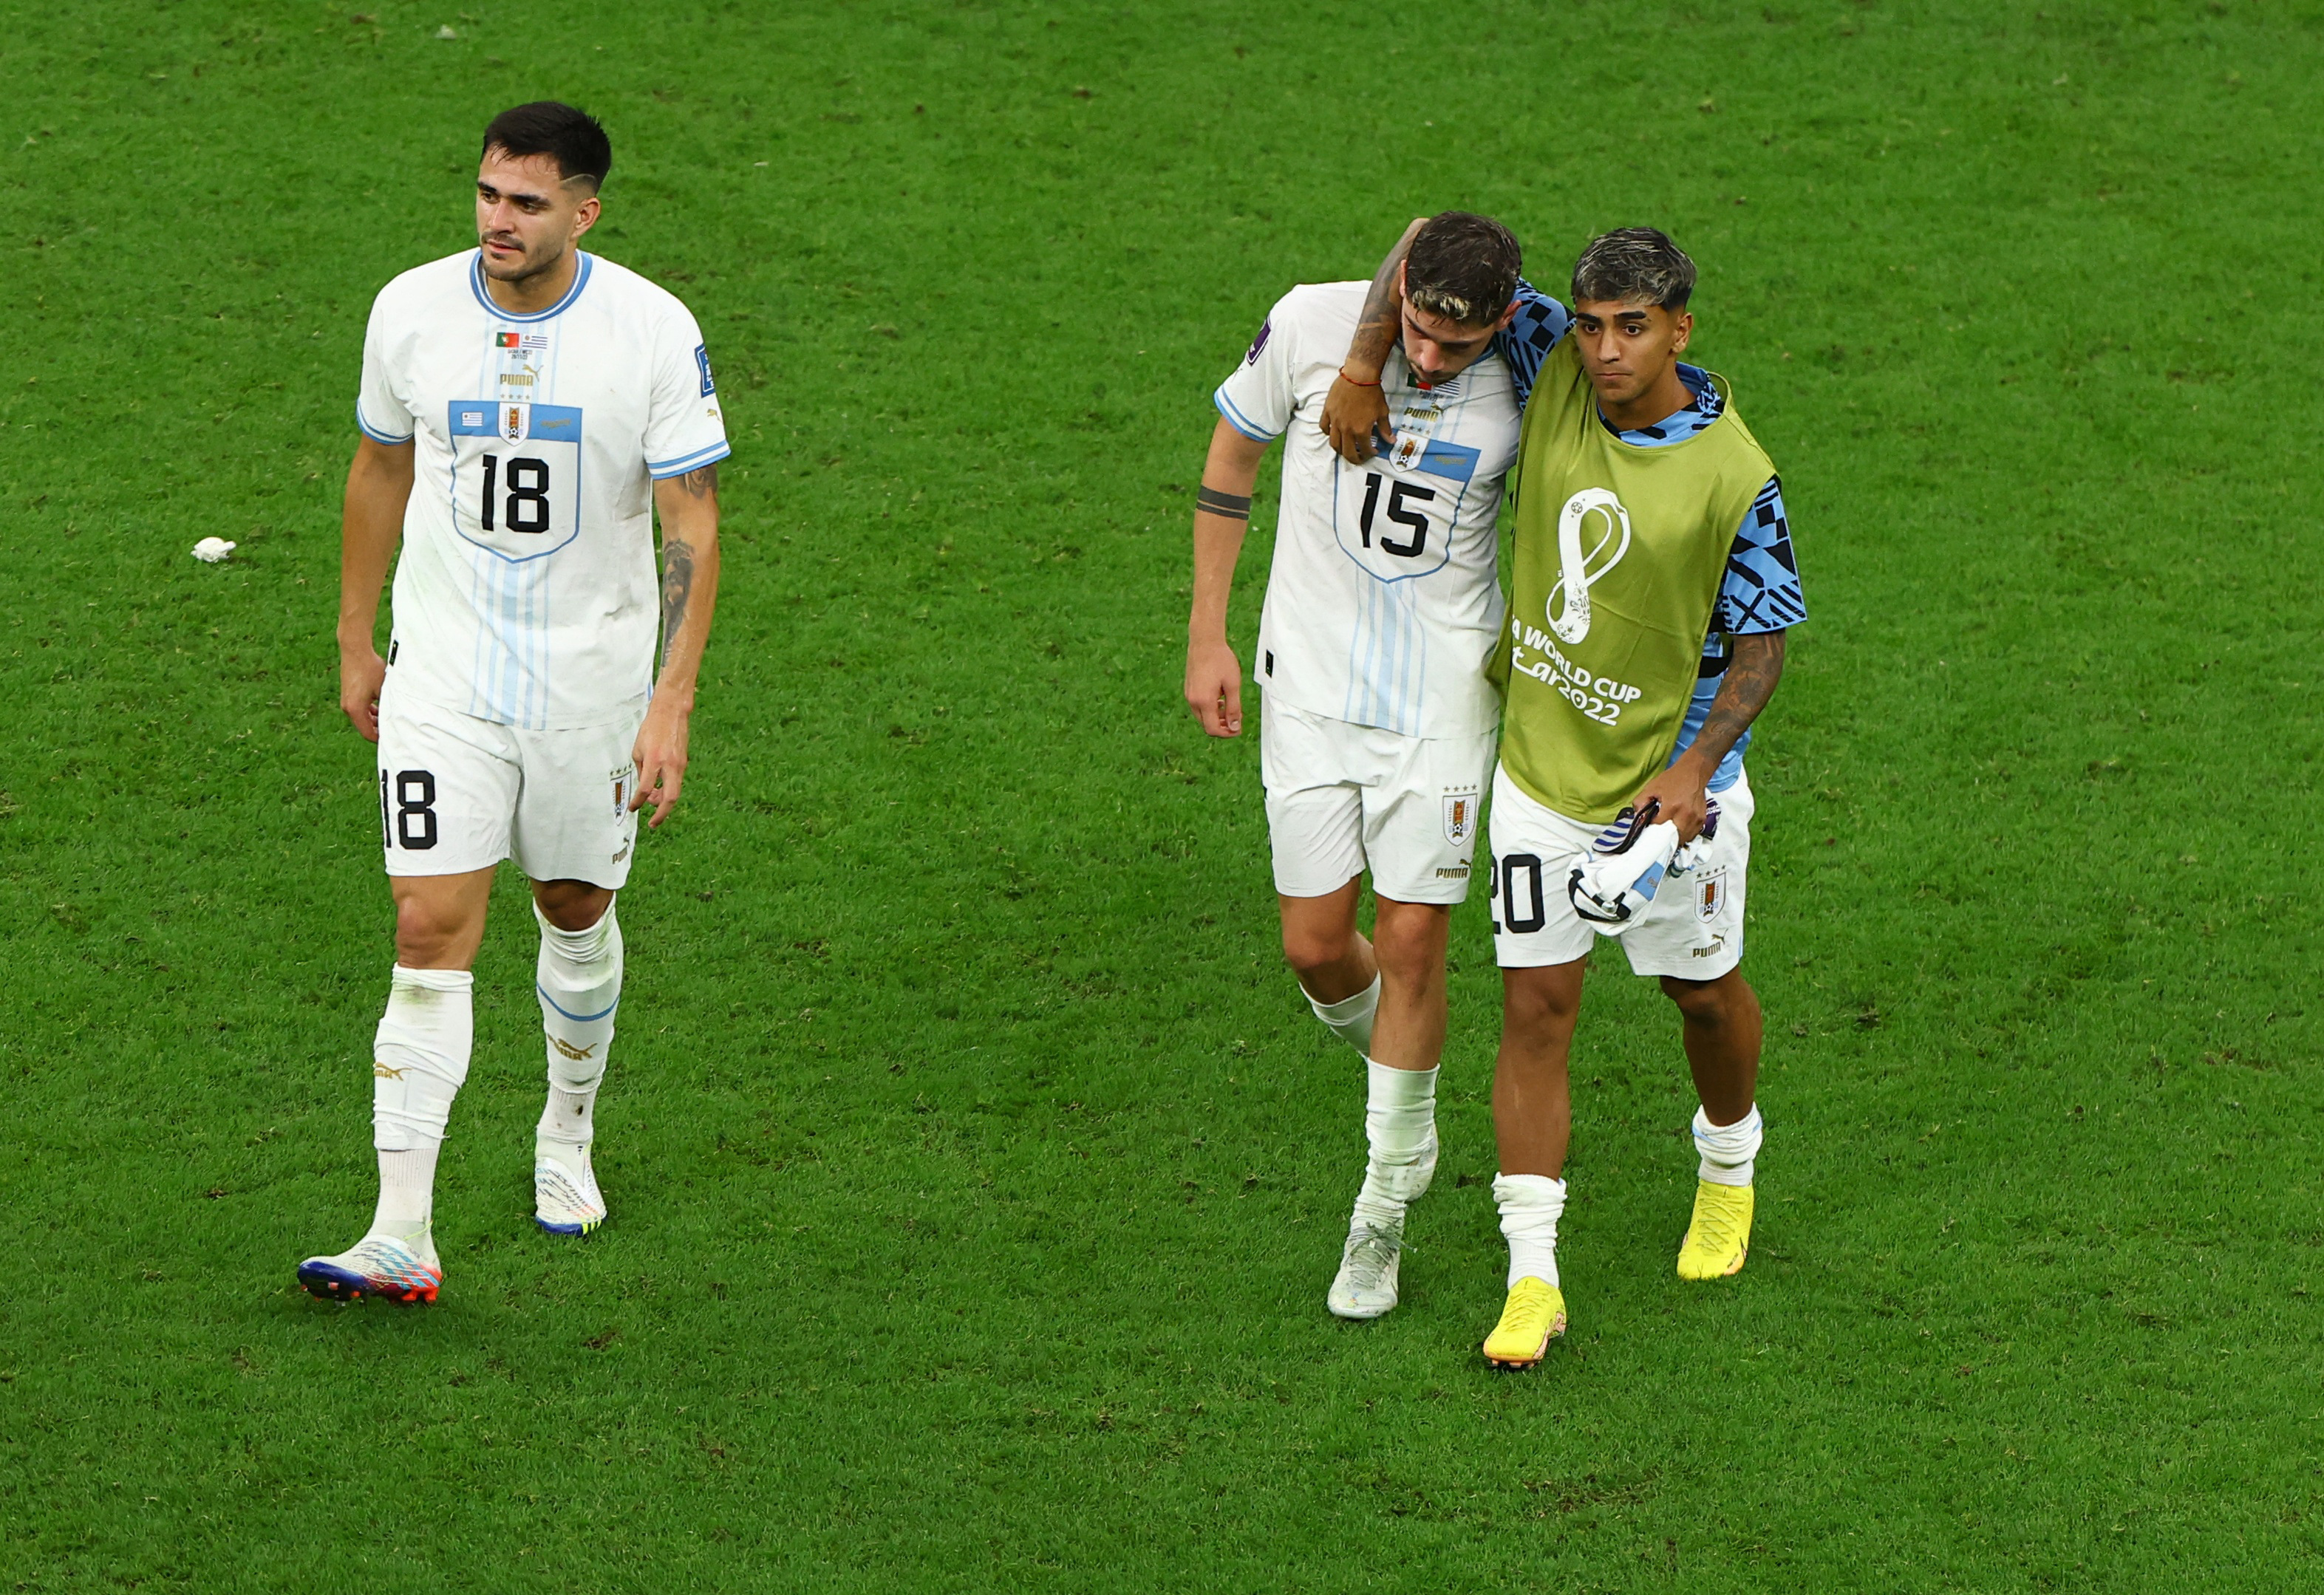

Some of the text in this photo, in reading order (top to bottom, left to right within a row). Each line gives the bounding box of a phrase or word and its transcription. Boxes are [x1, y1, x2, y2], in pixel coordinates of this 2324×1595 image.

[500, 374, 534, 386] PUMA
[1403, 407, 1439, 422] PUMA
[482, 454, 549, 533] 18
[1360, 473, 1436, 558] 15
[1523, 626, 1592, 687] WORLD
[1593, 677, 1642, 704] CUP
[381, 769, 437, 850] 18
[1436, 867, 1469, 879] PUMA
[1692, 941, 1722, 958] PUMA
